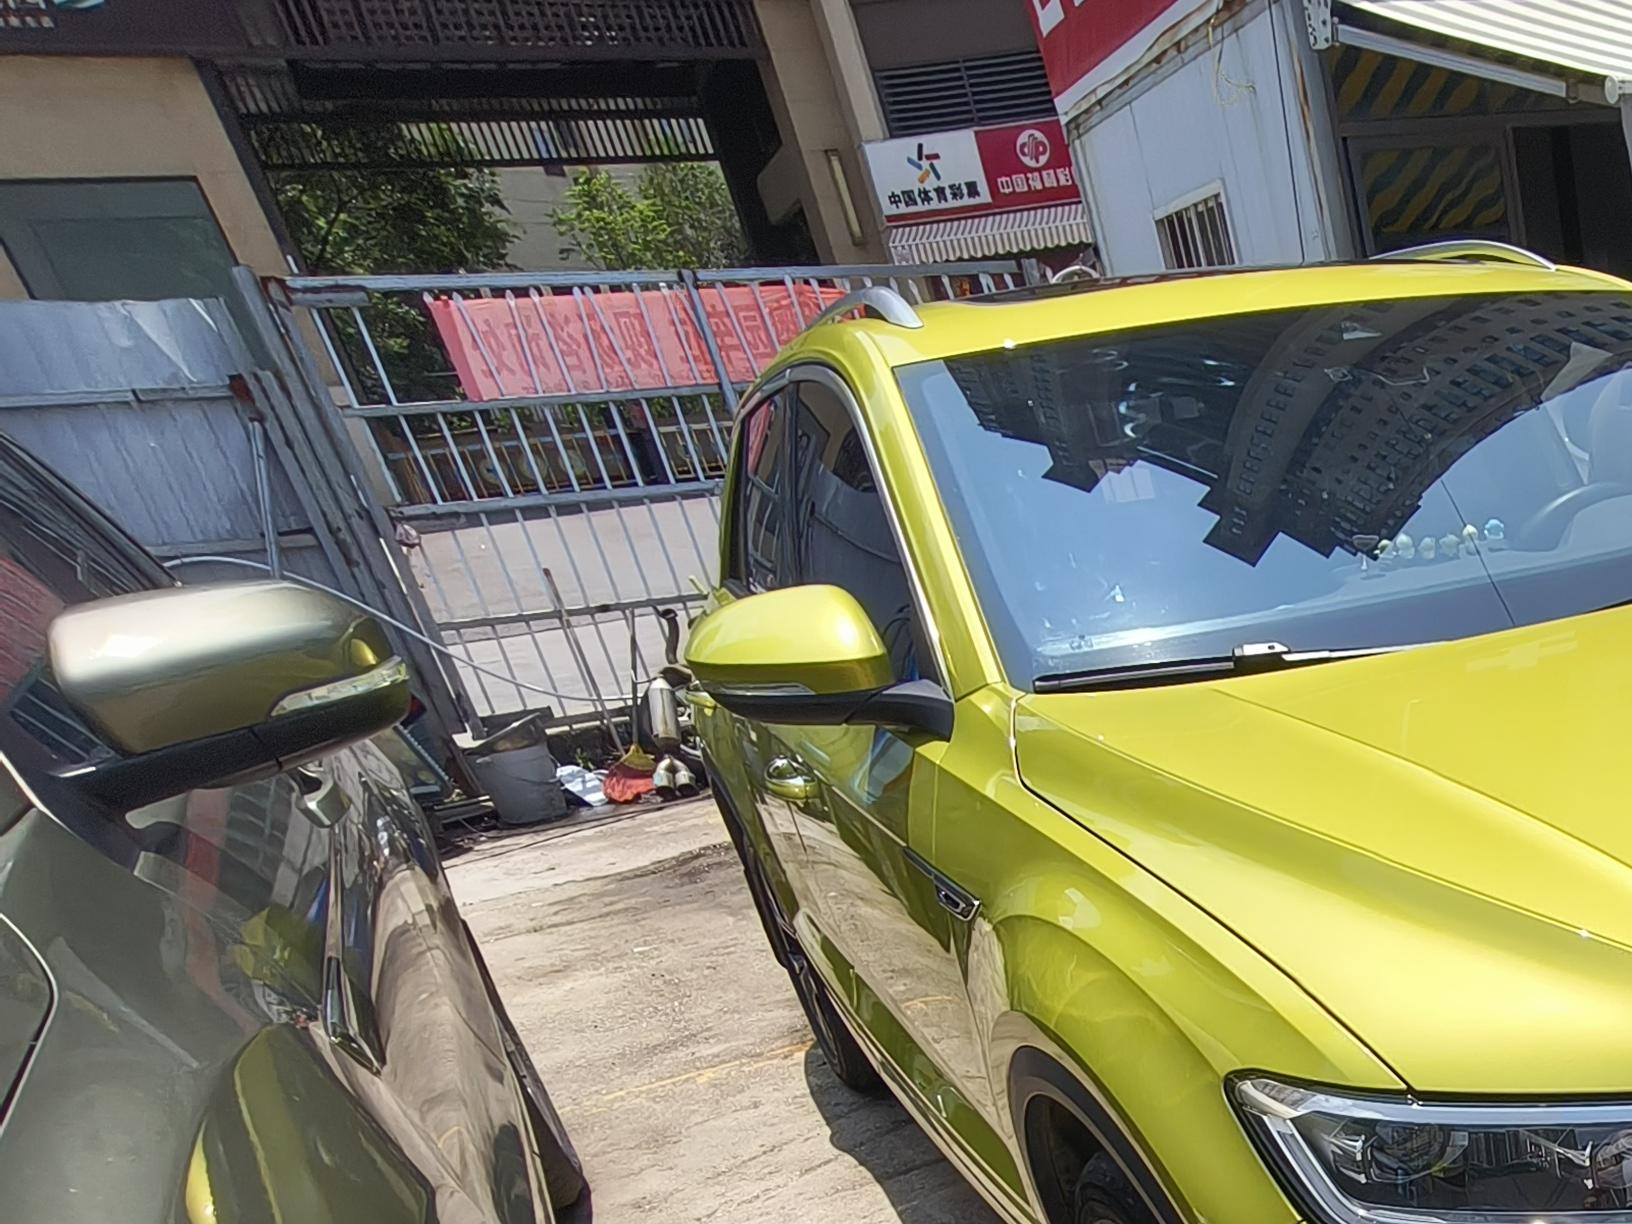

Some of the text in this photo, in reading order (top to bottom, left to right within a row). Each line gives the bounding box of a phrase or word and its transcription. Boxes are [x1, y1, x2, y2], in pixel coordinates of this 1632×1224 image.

[888, 181, 980, 209] 中国体育彩票
